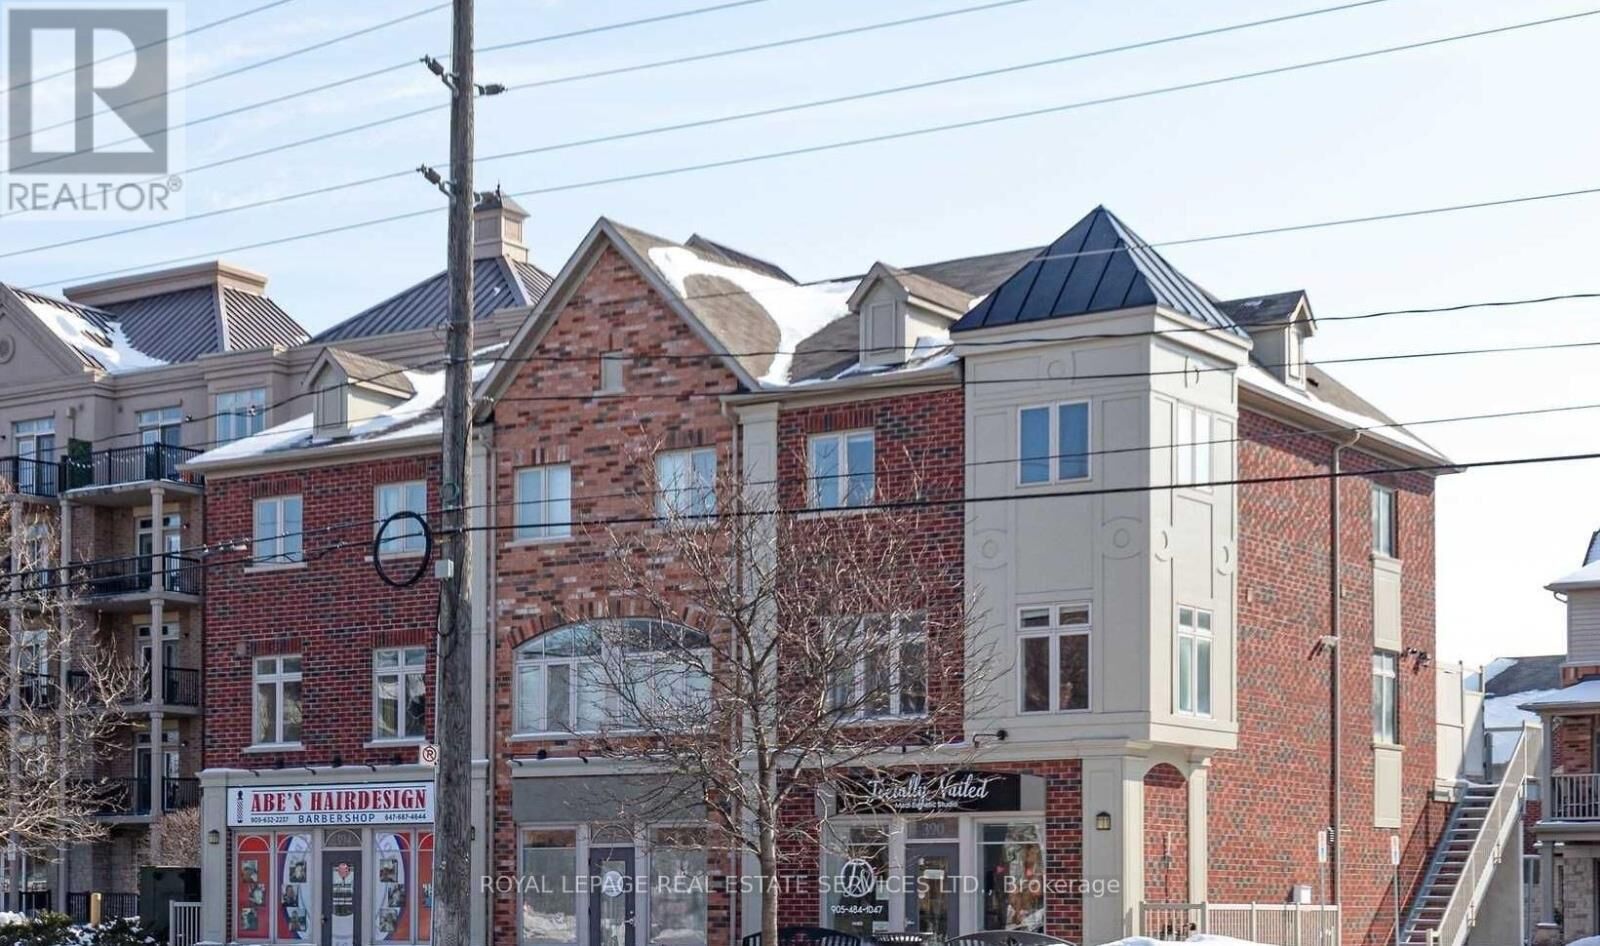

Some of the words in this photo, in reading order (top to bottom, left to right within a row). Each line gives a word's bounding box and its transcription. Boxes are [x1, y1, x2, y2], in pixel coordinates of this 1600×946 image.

[930, 774, 989, 799] Nailed
[251, 792, 302, 812] ABE'S
[310, 789, 426, 811] HAIRDESIGN
[298, 813, 376, 824] BARBERSHOP
